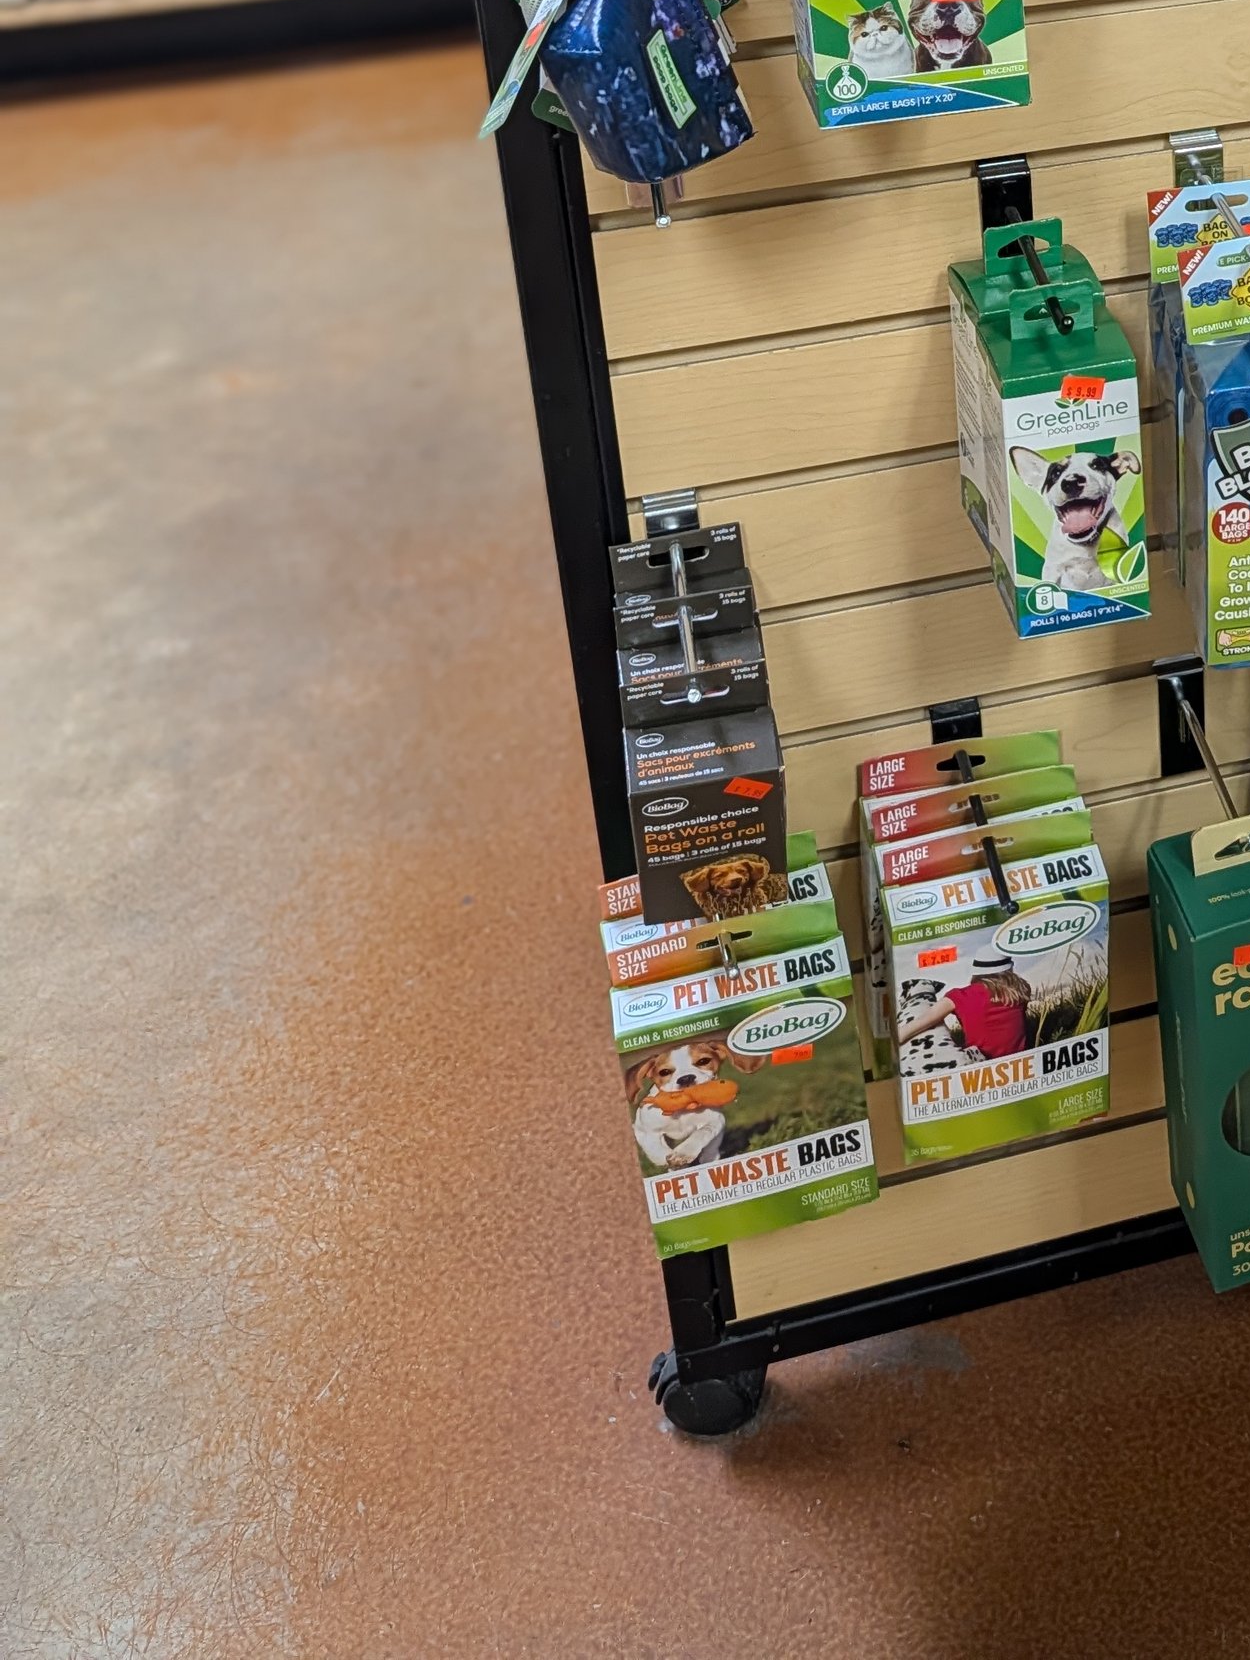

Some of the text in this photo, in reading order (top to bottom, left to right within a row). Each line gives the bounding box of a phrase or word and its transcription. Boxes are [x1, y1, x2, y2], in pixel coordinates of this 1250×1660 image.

[983, 65, 1024, 76] UNSCENTED
[832, 98, 916, 116] EXTRA LARGE BAGS
[1192, 320, 1233, 336] PREMIUM
[1017, 399, 1129, 431] GreenLine
[1218, 507, 1250, 524] 140
[1219, 522, 1250, 533] LARGE
[1222, 530, 1248, 540] BAGS
[1229, 583, 1243, 594] To
[1030, 609, 1092, 628] ROLLS 96 BAGS
[637, 741, 755, 769] Sacs pour excréments
[870, 757, 906, 776] LARGE
[870, 774, 896, 790] SIZE
[648, 801, 684, 813] BioBag
[644, 805, 759, 833] Responsible choice
[645, 820, 737, 843] Pet Waste
[646, 823, 765, 854] Bags on a roll
[1008, 915, 1088, 945] BioBag
[616, 937, 688, 968] STANDARD
[619, 961, 649, 981] SIZE
[623, 1017, 720, 1049] CLEAN & RESPONSIBLE
[745, 1012, 832, 1044] BioBag
[911, 1037, 1099, 1106] PET WASTE BAGS
[655, 1129, 861, 1205] PET WASTE BAGS
[662, 1152, 862, 1215] THE ALTERNATIVE TO REGULAR PLASTIC BAGS
